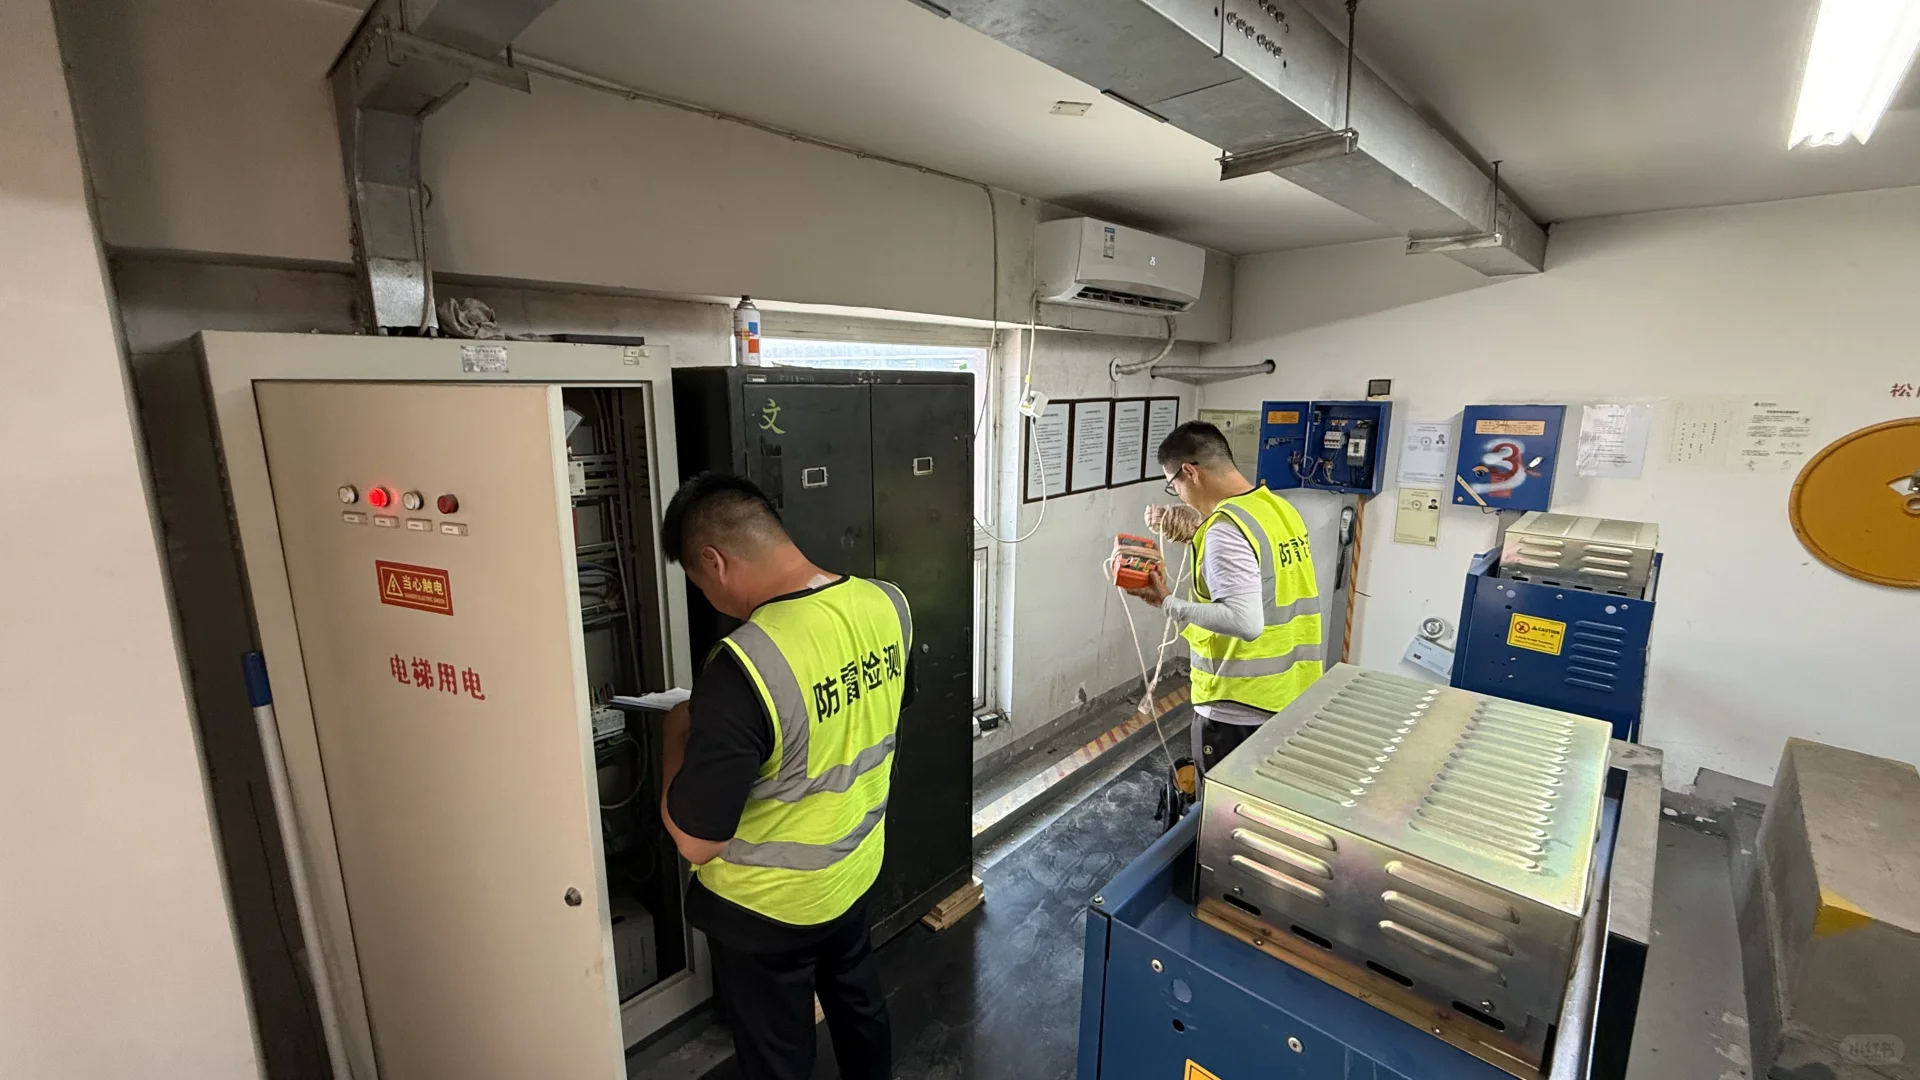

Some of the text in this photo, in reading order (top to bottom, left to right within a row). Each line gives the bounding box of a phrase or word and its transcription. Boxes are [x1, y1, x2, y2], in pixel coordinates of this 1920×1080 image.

[1890, 383, 1920, 398] 松
[758, 397, 786, 435] 文
[1490, 442, 1519, 482] 3
[401, 574, 445, 596] 当心触电
[1537, 626, 1560, 635] CAUTION
[389, 653, 486, 701] 电梯用电
[812, 640, 901, 724] 防雷检测
